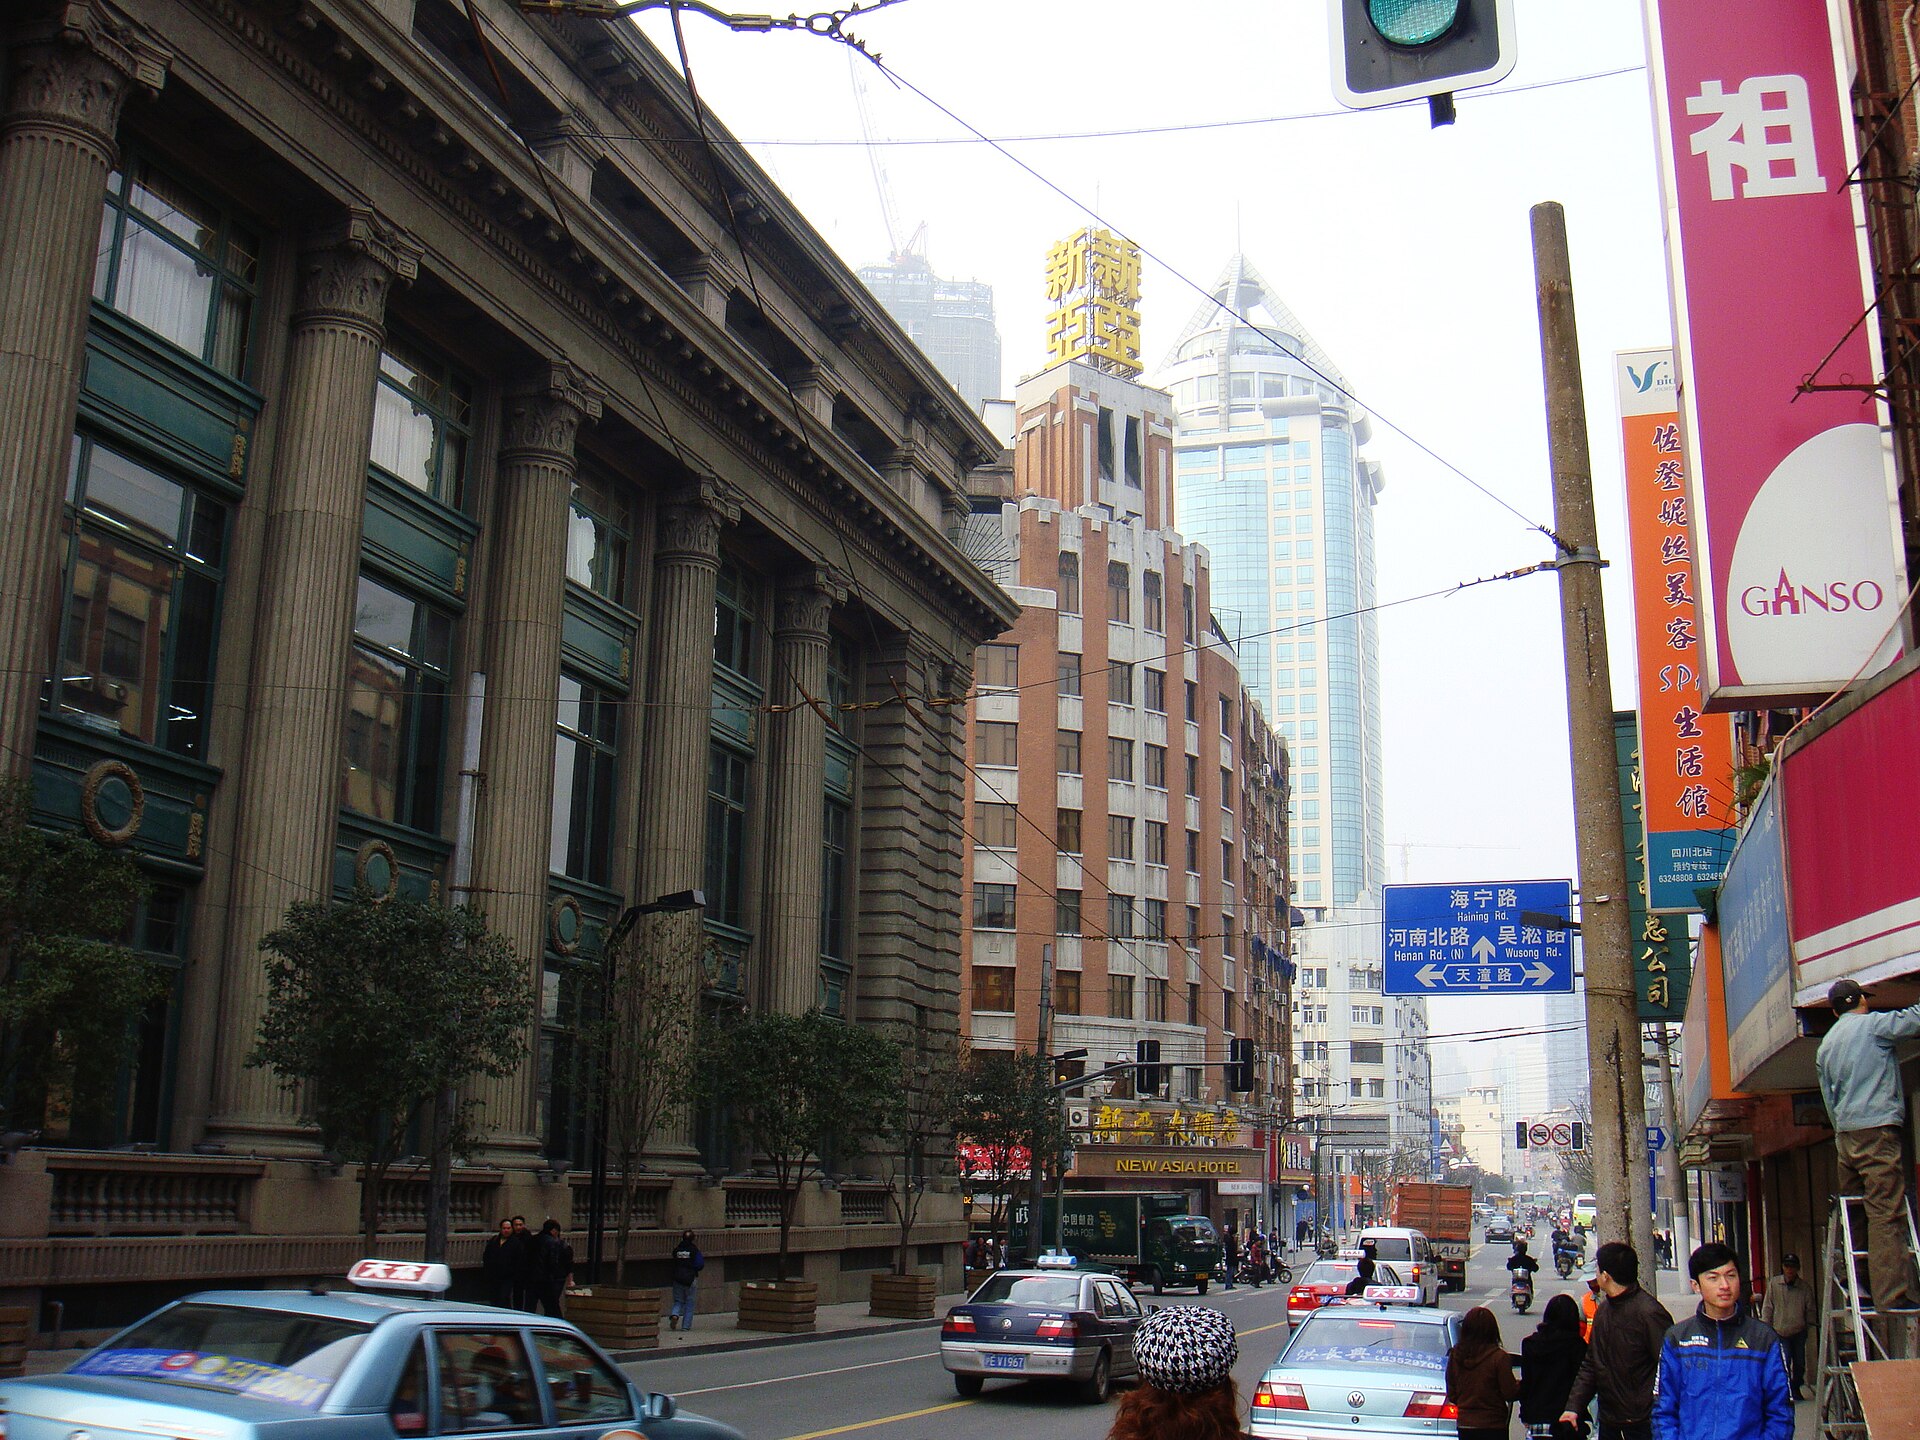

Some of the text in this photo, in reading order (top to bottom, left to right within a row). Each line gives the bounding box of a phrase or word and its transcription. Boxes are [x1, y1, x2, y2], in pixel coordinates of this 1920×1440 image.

[1686, 74, 1827, 201] 祖
[1741, 566, 1883, 616] GANSO
[1450, 888, 1518, 909] 海宁路
[1457, 910, 1509, 923] Haining Rd.
[1388, 926, 1470, 947] 河南北路
[1498, 925, 1566, 945] 吴淞路
[1394, 948, 1465, 962] Henan Rd. (N)
[1505, 946, 1562, 960] Wusong Rd.
[1456, 967, 1512, 983] 天潼路
[1116, 1159, 1242, 1174] NEW ASIA HOTEL
[1062, 1213, 1094, 1226] 中国邮政
[1063, 1228, 1094, 1237] CHINA POST
[360, 1263, 422, 1280] 大众
[1372, 1288, 1411, 1298] 大众
